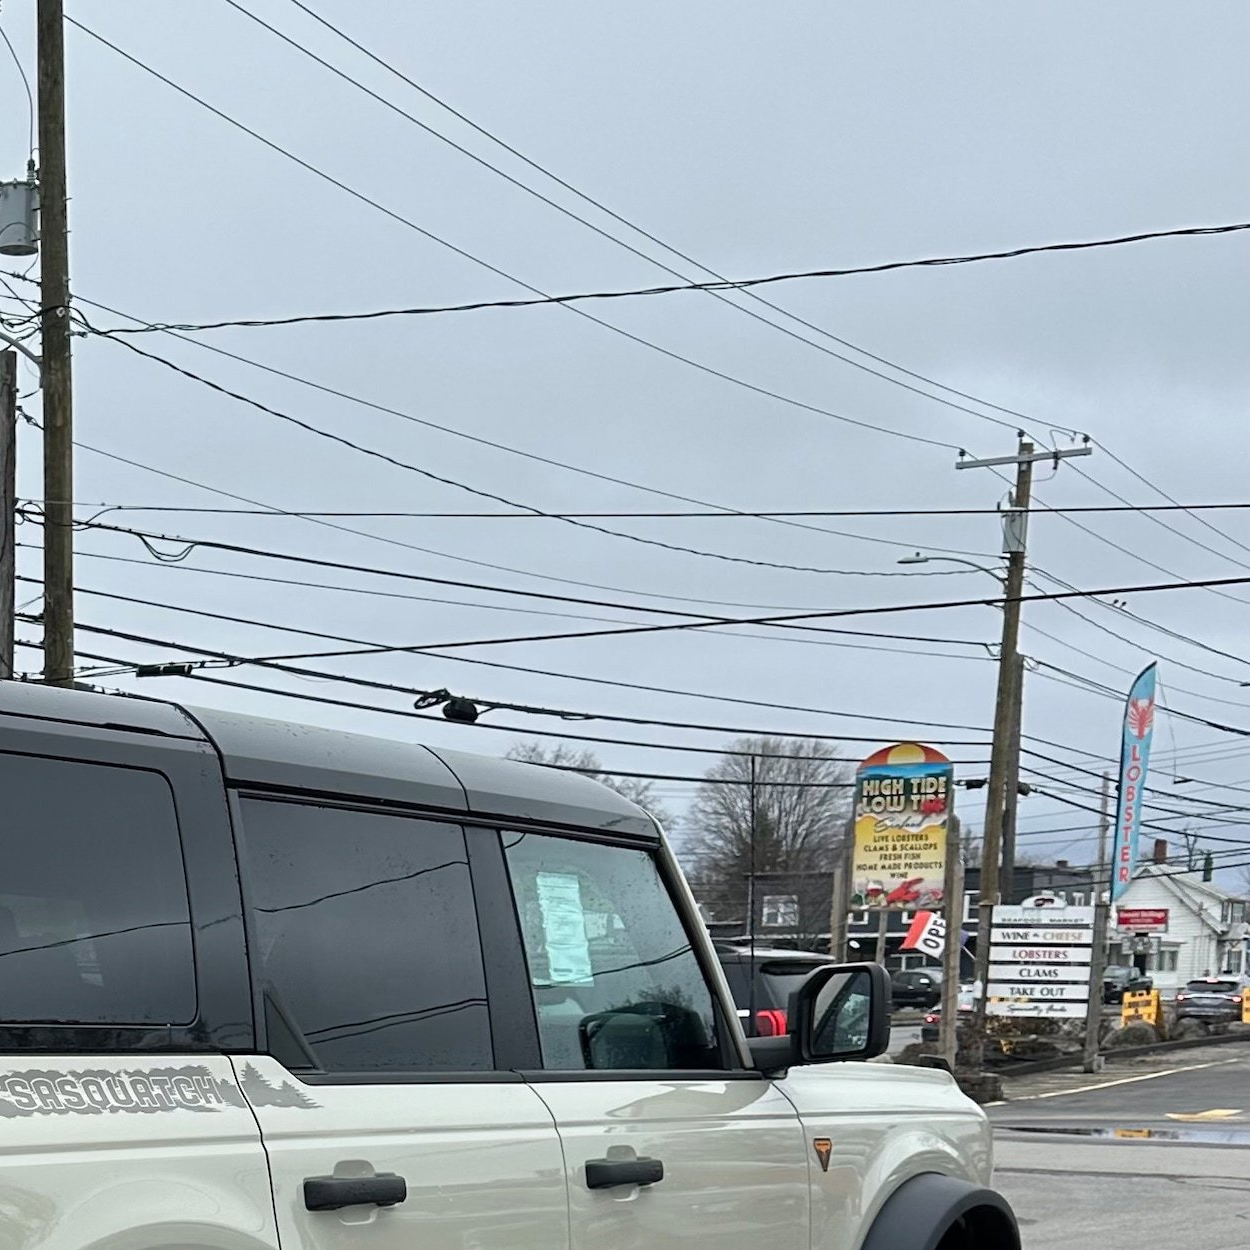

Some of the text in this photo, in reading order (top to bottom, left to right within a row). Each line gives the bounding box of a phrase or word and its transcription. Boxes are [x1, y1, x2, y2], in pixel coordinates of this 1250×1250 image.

[862, 776, 947, 796] HIGH TIDE
[862, 796, 905, 813] LOW
[1118, 745, 1142, 882] LOBSTER
[873, 833, 929, 843] LIVE LOBSTERS
[863, 842, 938, 852] CLAMS & SCALLOPS
[879, 852, 921, 861] FRESH FISH
[856, 861, 943, 871] HOME MADE PRODUCTS
[922, 918, 947, 949] OPE
[1001, 931, 1030, 940] WINE
[1042, 931, 1084, 941] CHEESE
[1012, 949, 1069, 959] LOBSTERS
[1018, 968, 1059, 978] CLAMS
[1009, 986, 1067, 997] TAKE OUT
[5, 1075, 223, 1111] SASQUATCH
